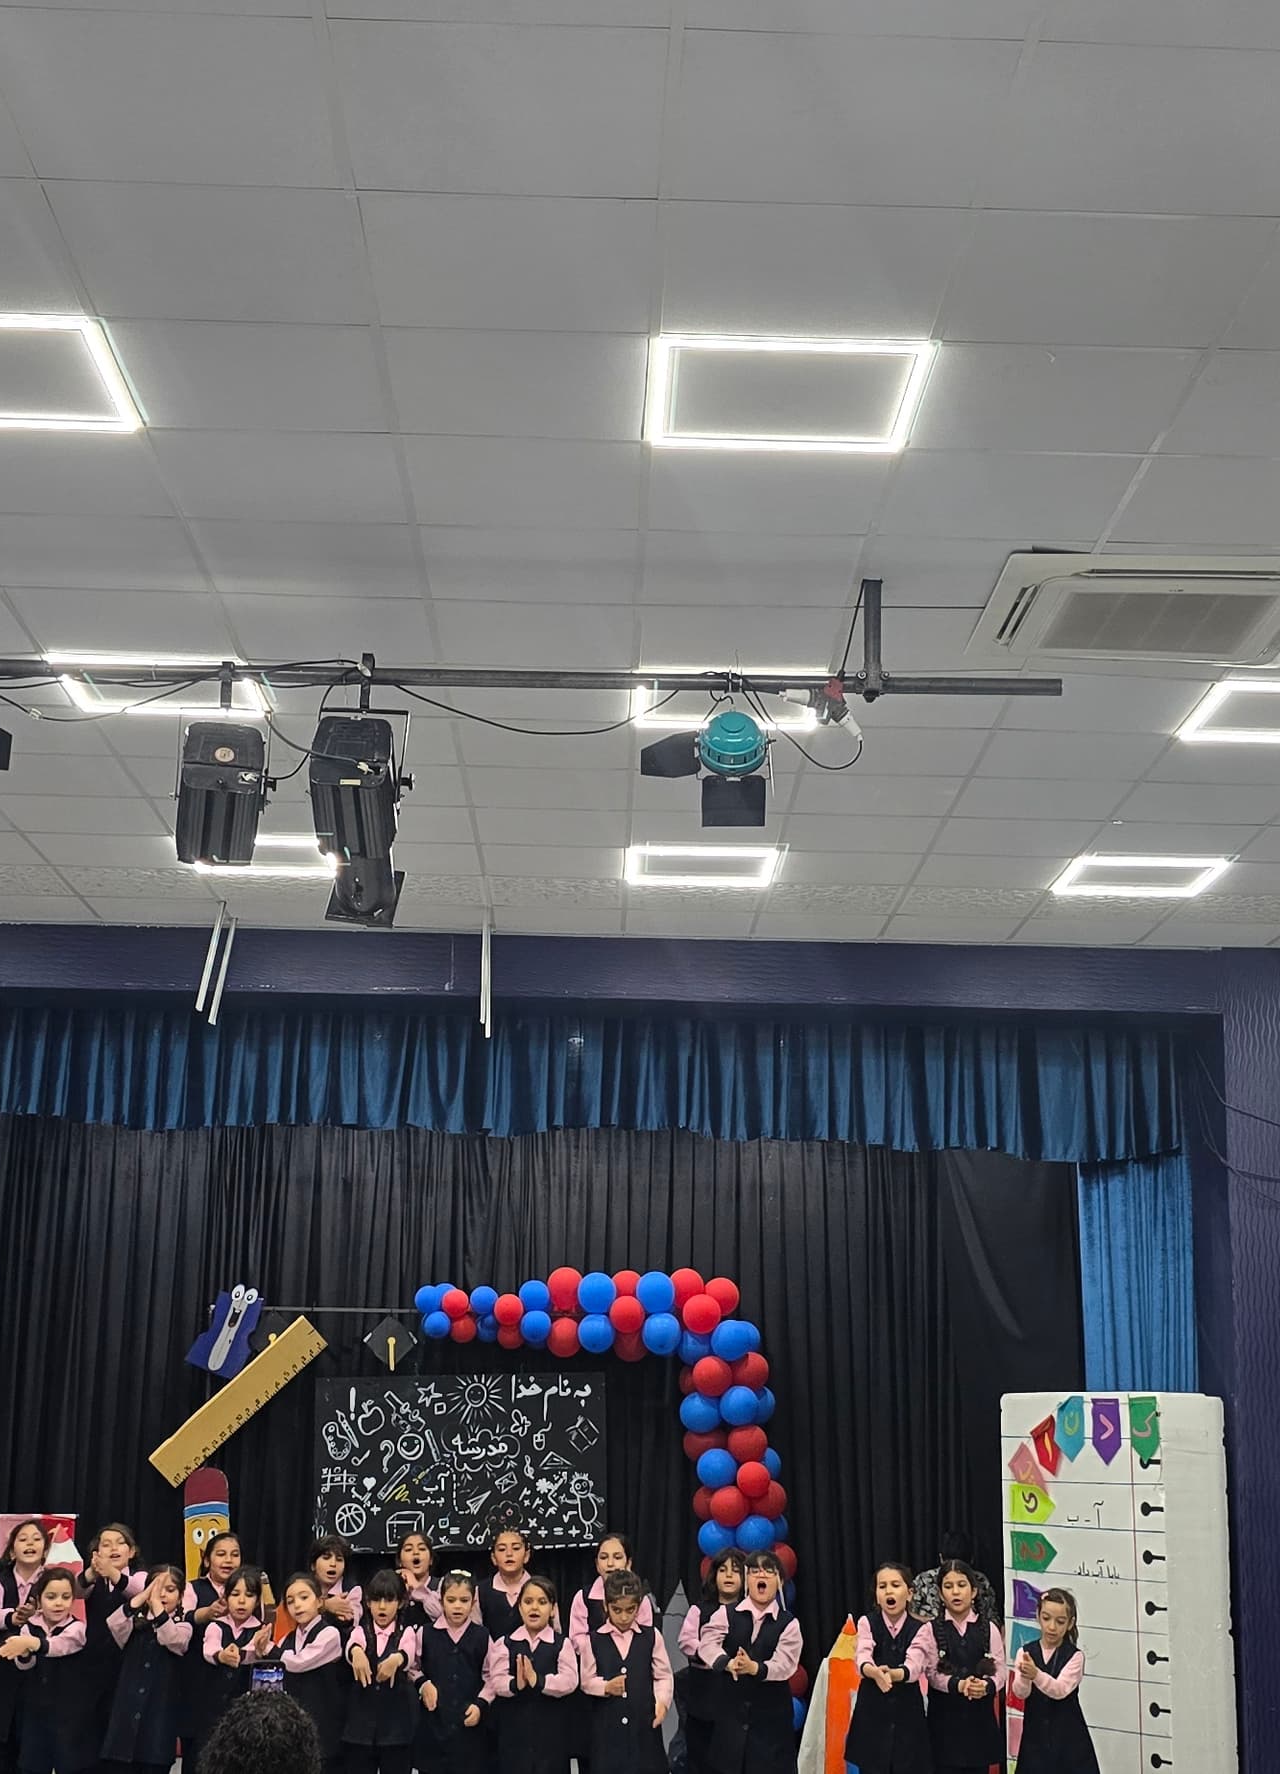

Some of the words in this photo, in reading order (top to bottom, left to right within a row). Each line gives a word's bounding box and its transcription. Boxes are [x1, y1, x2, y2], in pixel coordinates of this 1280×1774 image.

[543, 1374, 571, 1422] نام
[573, 1383, 592, 1407] به
[451, 1433, 508, 1460] مدرسه
[423, 1470, 450, 1494] آب
